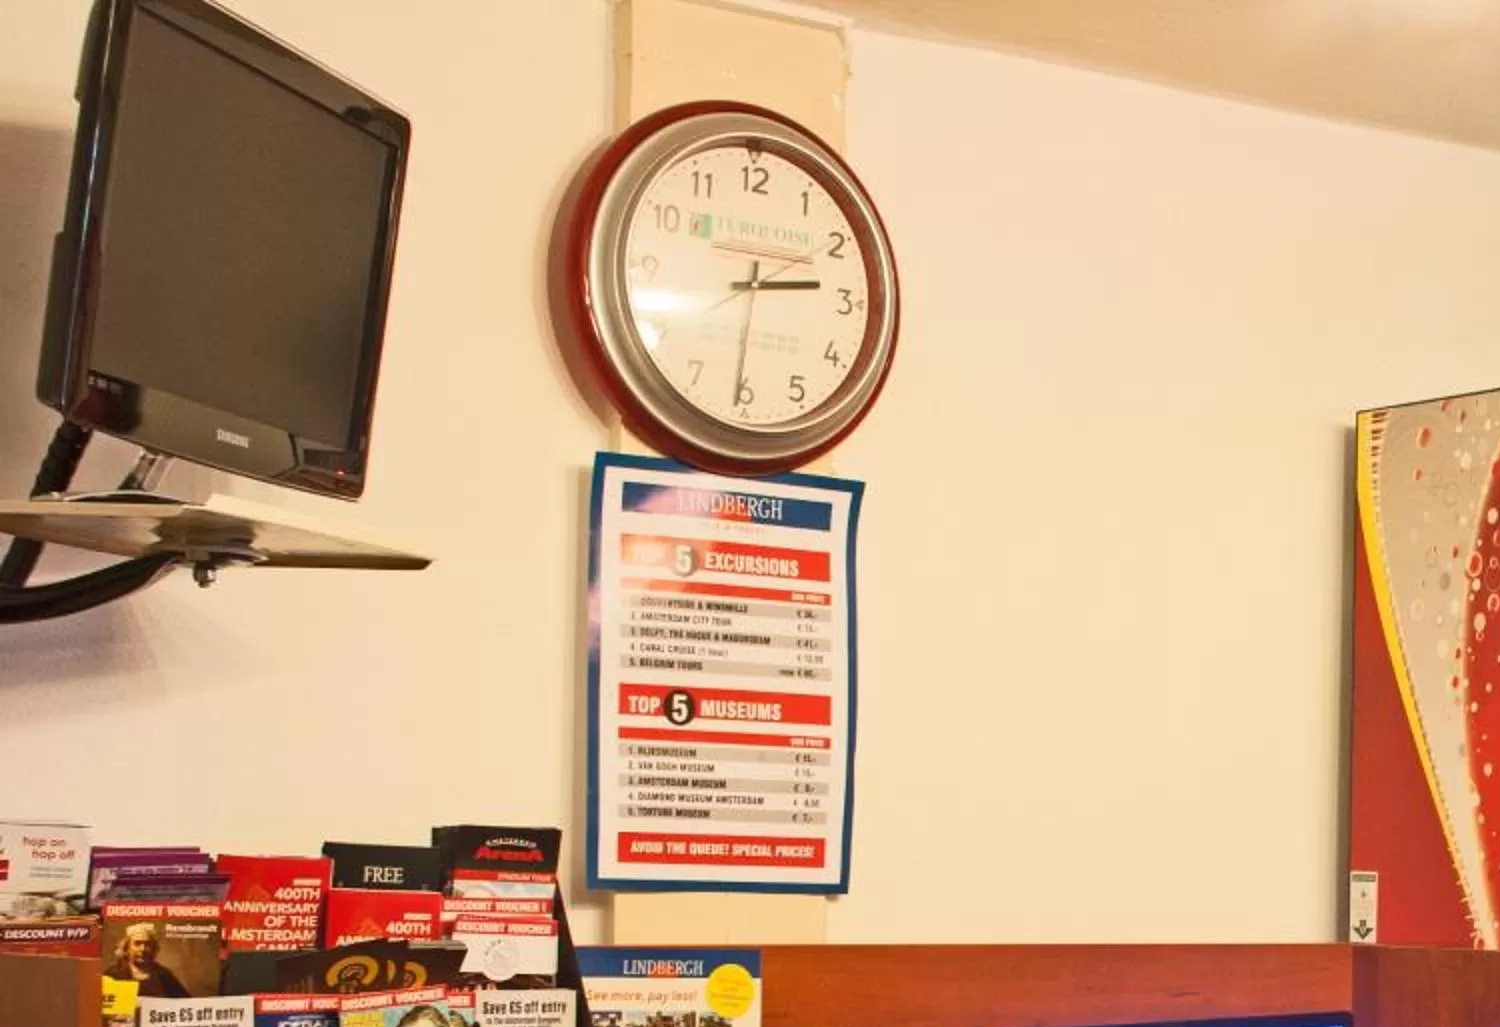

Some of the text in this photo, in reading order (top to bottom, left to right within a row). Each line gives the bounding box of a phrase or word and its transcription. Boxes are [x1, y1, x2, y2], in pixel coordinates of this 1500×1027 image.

[691, 172, 713, 198] 11
[741, 167, 769, 194] 12
[800, 191, 810, 216] 1
[654, 204, 681, 231] 10
[828, 232, 845, 259] 2
[836, 288, 853, 315] 3
[824, 341, 840, 368] 4
[687, 360, 705, 387] 7
[738, 377, 754, 405] 6
[789, 376, 805, 403] 5
[678, 489, 783, 520] LINDBERGH
[675, 545, 799, 577] 5 EXCURSIONS
[640, 613, 690, 625] AMSTERDAM
[628, 693, 782, 722] TOP 5 MUSEUMS
[680, 763, 715, 773] MUSEUM
[637, 776, 690, 788] AMSTERDAM
[691, 778, 727, 789] MUSEUM
[22, 836, 66, 848] hop on
[31, 848, 75, 860] hop off
[363, 866, 404, 884] FREE
[274, 888, 321, 900] 400TH
[106, 905, 219, 917] DISCOUNT VOUCHER
[224, 901, 319, 914] ANNIVERSARY
[264, 916, 318, 927] OF THE
[385, 923, 431, 935] 400TH
[4, 927, 65, 940] DISCOUNT
[623, 959, 704, 977] LINDBERGH
[587, 990, 607, 1001] See
[648, 991, 668, 1004] pay
[149, 1009, 176, 1023] Save
[196, 1008, 212, 1021] off
[215, 1008, 244, 1021] entry
[482, 1002, 507, 1014] Save
[524, 1001, 539, 1013] off
[541, 1001, 567, 1014] entry
